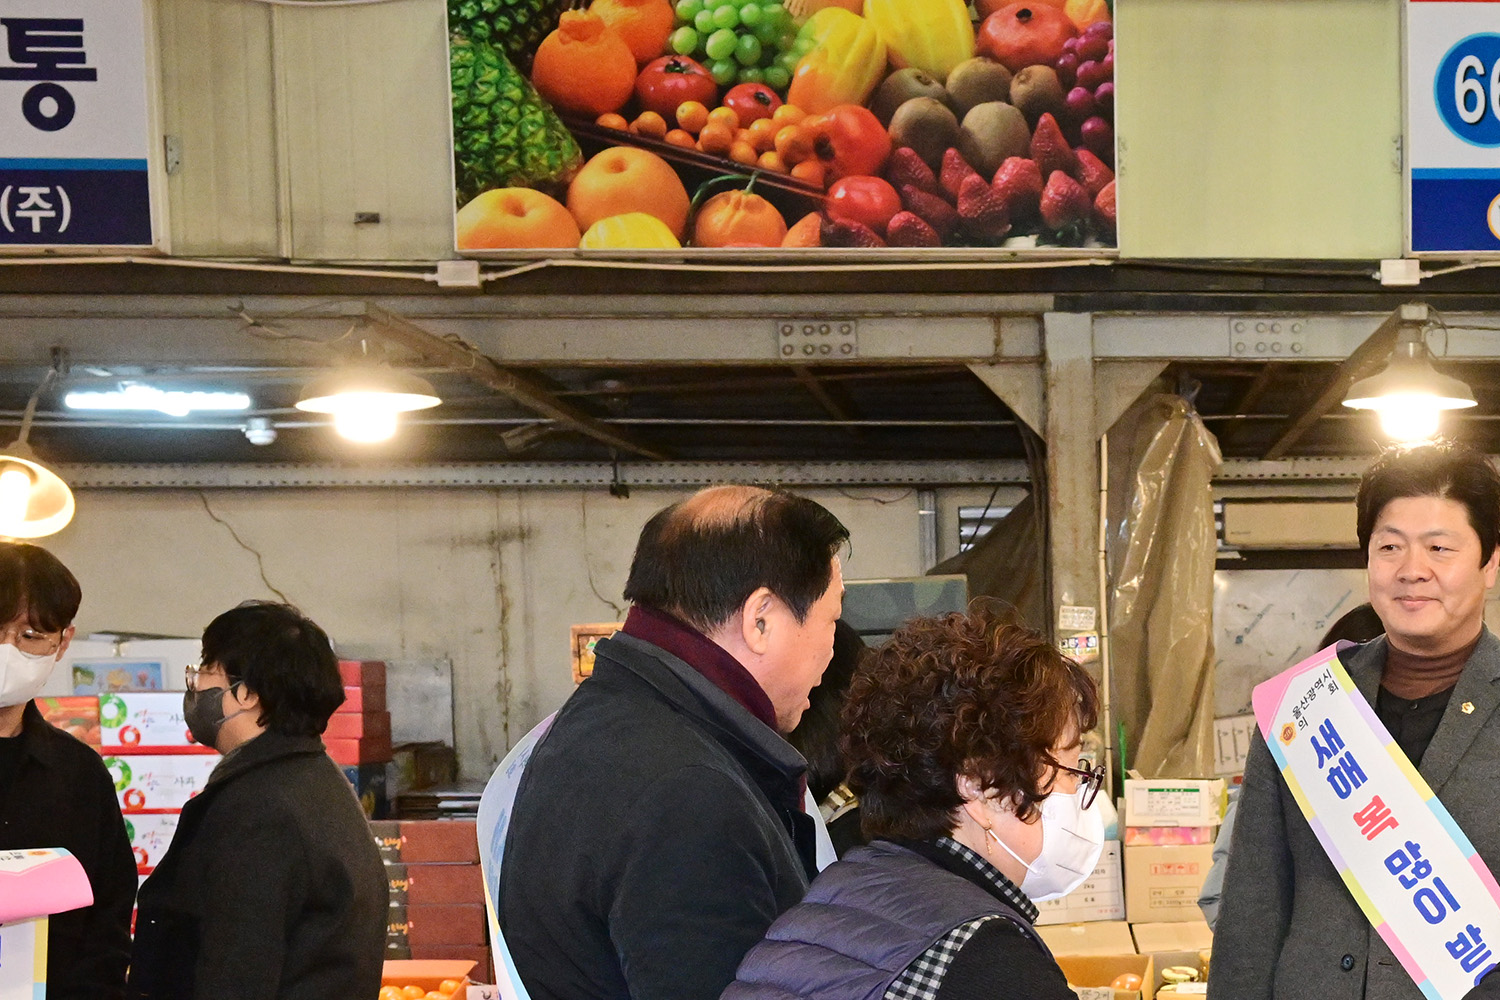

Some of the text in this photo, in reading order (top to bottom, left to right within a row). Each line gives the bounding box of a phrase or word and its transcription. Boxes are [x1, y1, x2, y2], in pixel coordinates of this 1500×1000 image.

[0, 17, 97, 132] 통
[0, 184, 71, 234] (주)
[1292, 668, 1332, 720] 울산광역시
[1310, 718, 1497, 986] 새해 복 많이 받
